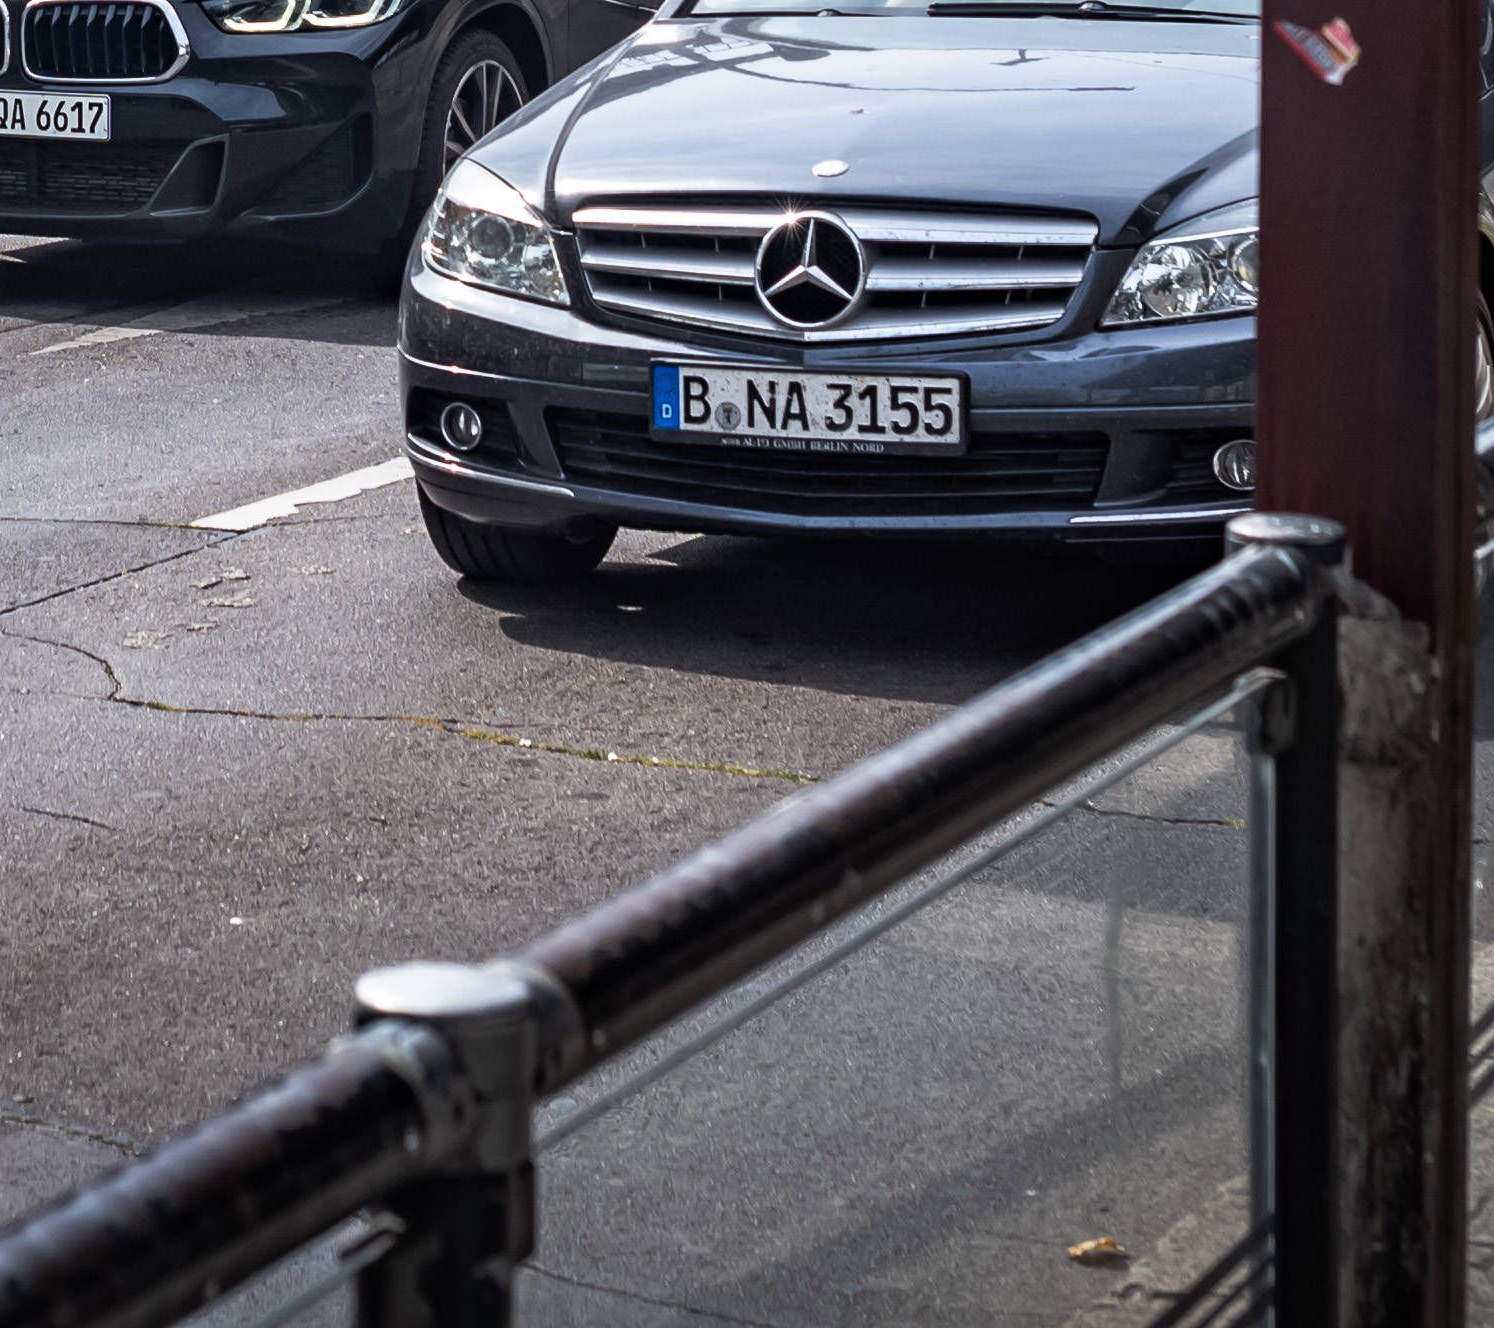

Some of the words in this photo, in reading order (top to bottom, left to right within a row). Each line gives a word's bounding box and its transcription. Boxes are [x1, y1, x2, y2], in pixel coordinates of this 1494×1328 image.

[36, 100, 104, 134] 6617
[662, 403, 672, 418] D
[682, 375, 712, 425] B
[747, 379, 810, 431] NA
[824, 383, 953, 435] 3155
[773, 439, 806, 450] GMBH
[810, 440, 849, 452] BERLIN
[852, 443, 884, 454] NORD
